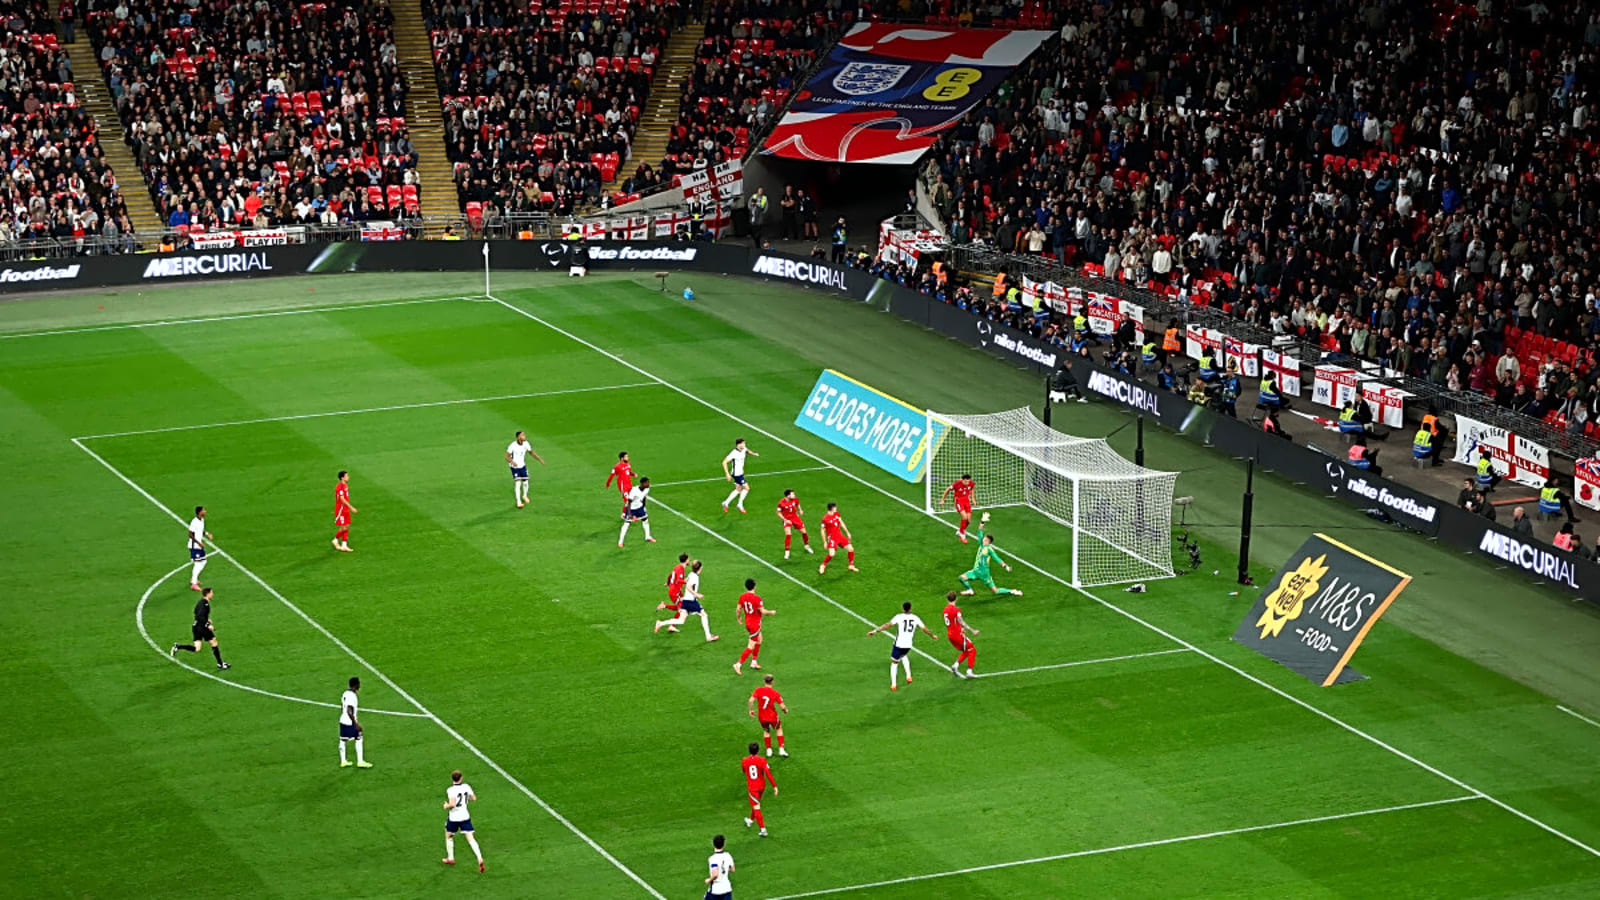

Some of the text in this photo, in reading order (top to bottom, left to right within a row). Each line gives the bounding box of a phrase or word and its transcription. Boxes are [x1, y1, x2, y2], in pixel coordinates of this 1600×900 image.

[831, 98, 867, 107] PARTNER
[693, 174, 735, 194] ENGLAND
[701, 188, 732, 202] LOAL
[246, 238, 270, 246] PLAY
[619, 246, 697, 261] football
[143, 253, 273, 278] MERCURIAL
[752, 255, 848, 291] MERCURIAL
[993, 333, 1057, 368] nike football
[1087, 370, 1161, 417] MERCURIAL
[805, 383, 838, 422] EE
[825, 393, 876, 440] DOES
[864, 411, 922, 462] MORE
[1529, 463, 1543, 475] FC
[1347, 478, 1436, 522] nike football
[1479, 529, 1580, 590] MERCURIAL
[1288, 573, 1313, 591] eat
[744, 601, 754, 615] 13
[1308, 576, 1376, 632] M&S
[904, 619, 915, 633] 15
[943, 613, 951, 627] 6
[762, 696, 770, 710] 7
[749, 764, 758, 780] 8
[456, 791, 468, 808] 21
